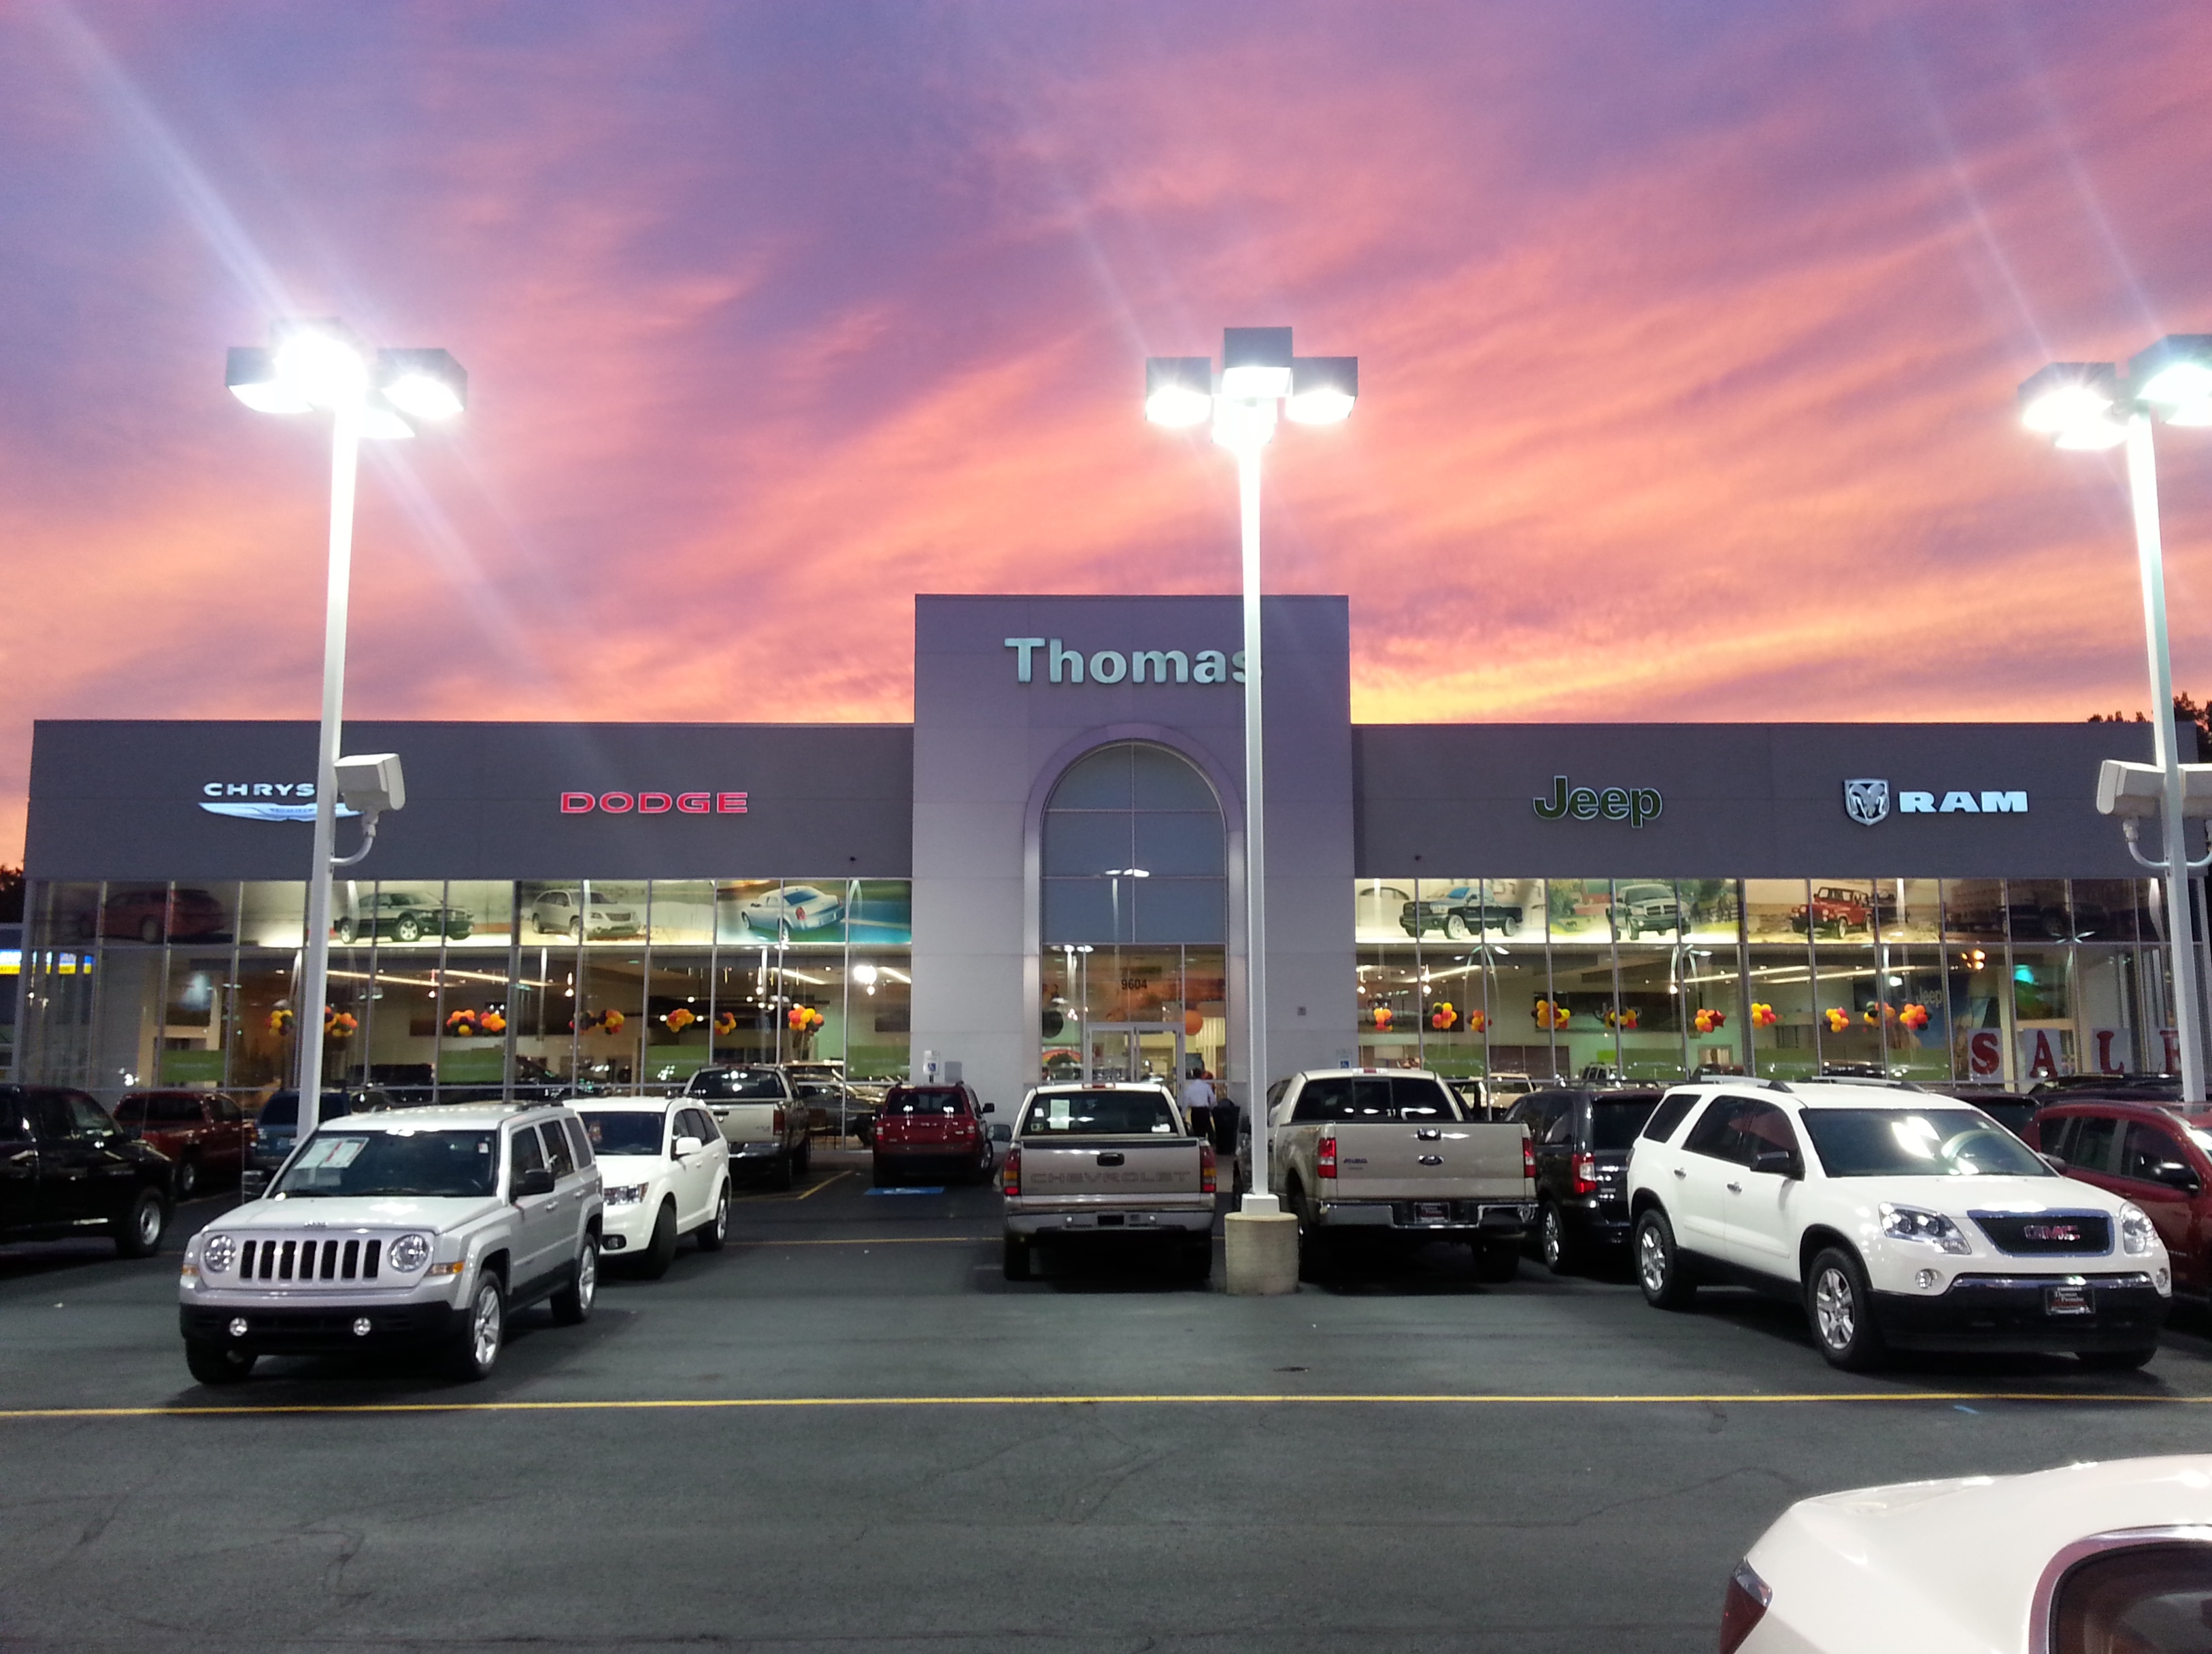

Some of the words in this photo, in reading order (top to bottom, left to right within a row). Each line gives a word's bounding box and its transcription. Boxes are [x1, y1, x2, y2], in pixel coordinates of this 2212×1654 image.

[203, 782, 316, 796] CHRYS
[560, 792, 748, 813] DODGE
[1532, 775, 1663, 828] Jeep
[1899, 791, 2028, 813] RAM
[1122, 979, 1147, 990] 9604
[1915, 985, 1943, 1008] Jeep
[1030, 1171, 1191, 1183] CHEVROLET
[2024, 1225, 2081, 1240] GMC
